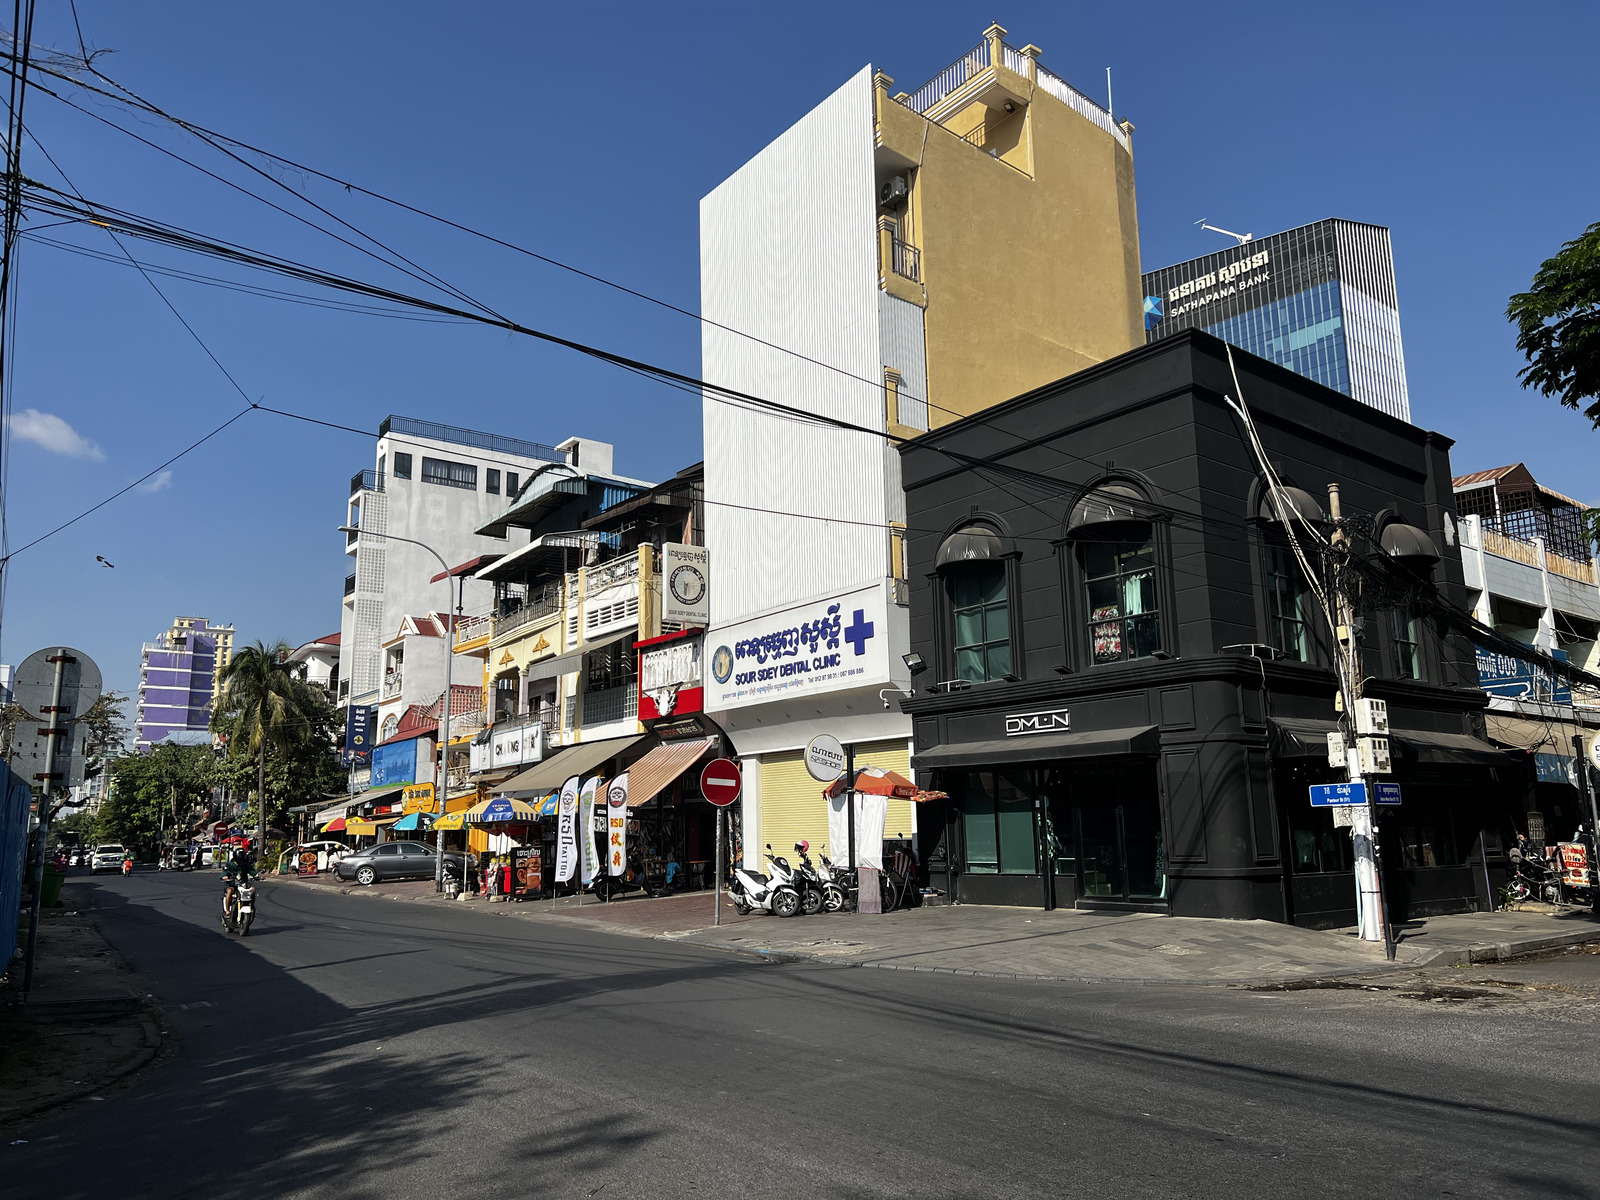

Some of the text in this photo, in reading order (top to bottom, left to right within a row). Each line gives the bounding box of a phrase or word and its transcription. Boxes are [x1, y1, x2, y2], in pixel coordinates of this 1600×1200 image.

[1168, 250, 1269, 302] ធនាគារ ស្ថាបនា
[1170, 271, 1271, 318] SATHAPANA BANK
[735, 627, 800, 664] ពេទ្យធ្មេញ
[735, 653, 841, 686] SOUR SDEY DENTAL CLINIC
[1497, 654, 1517, 677] 009
[559, 845, 568, 877] TATTOO
